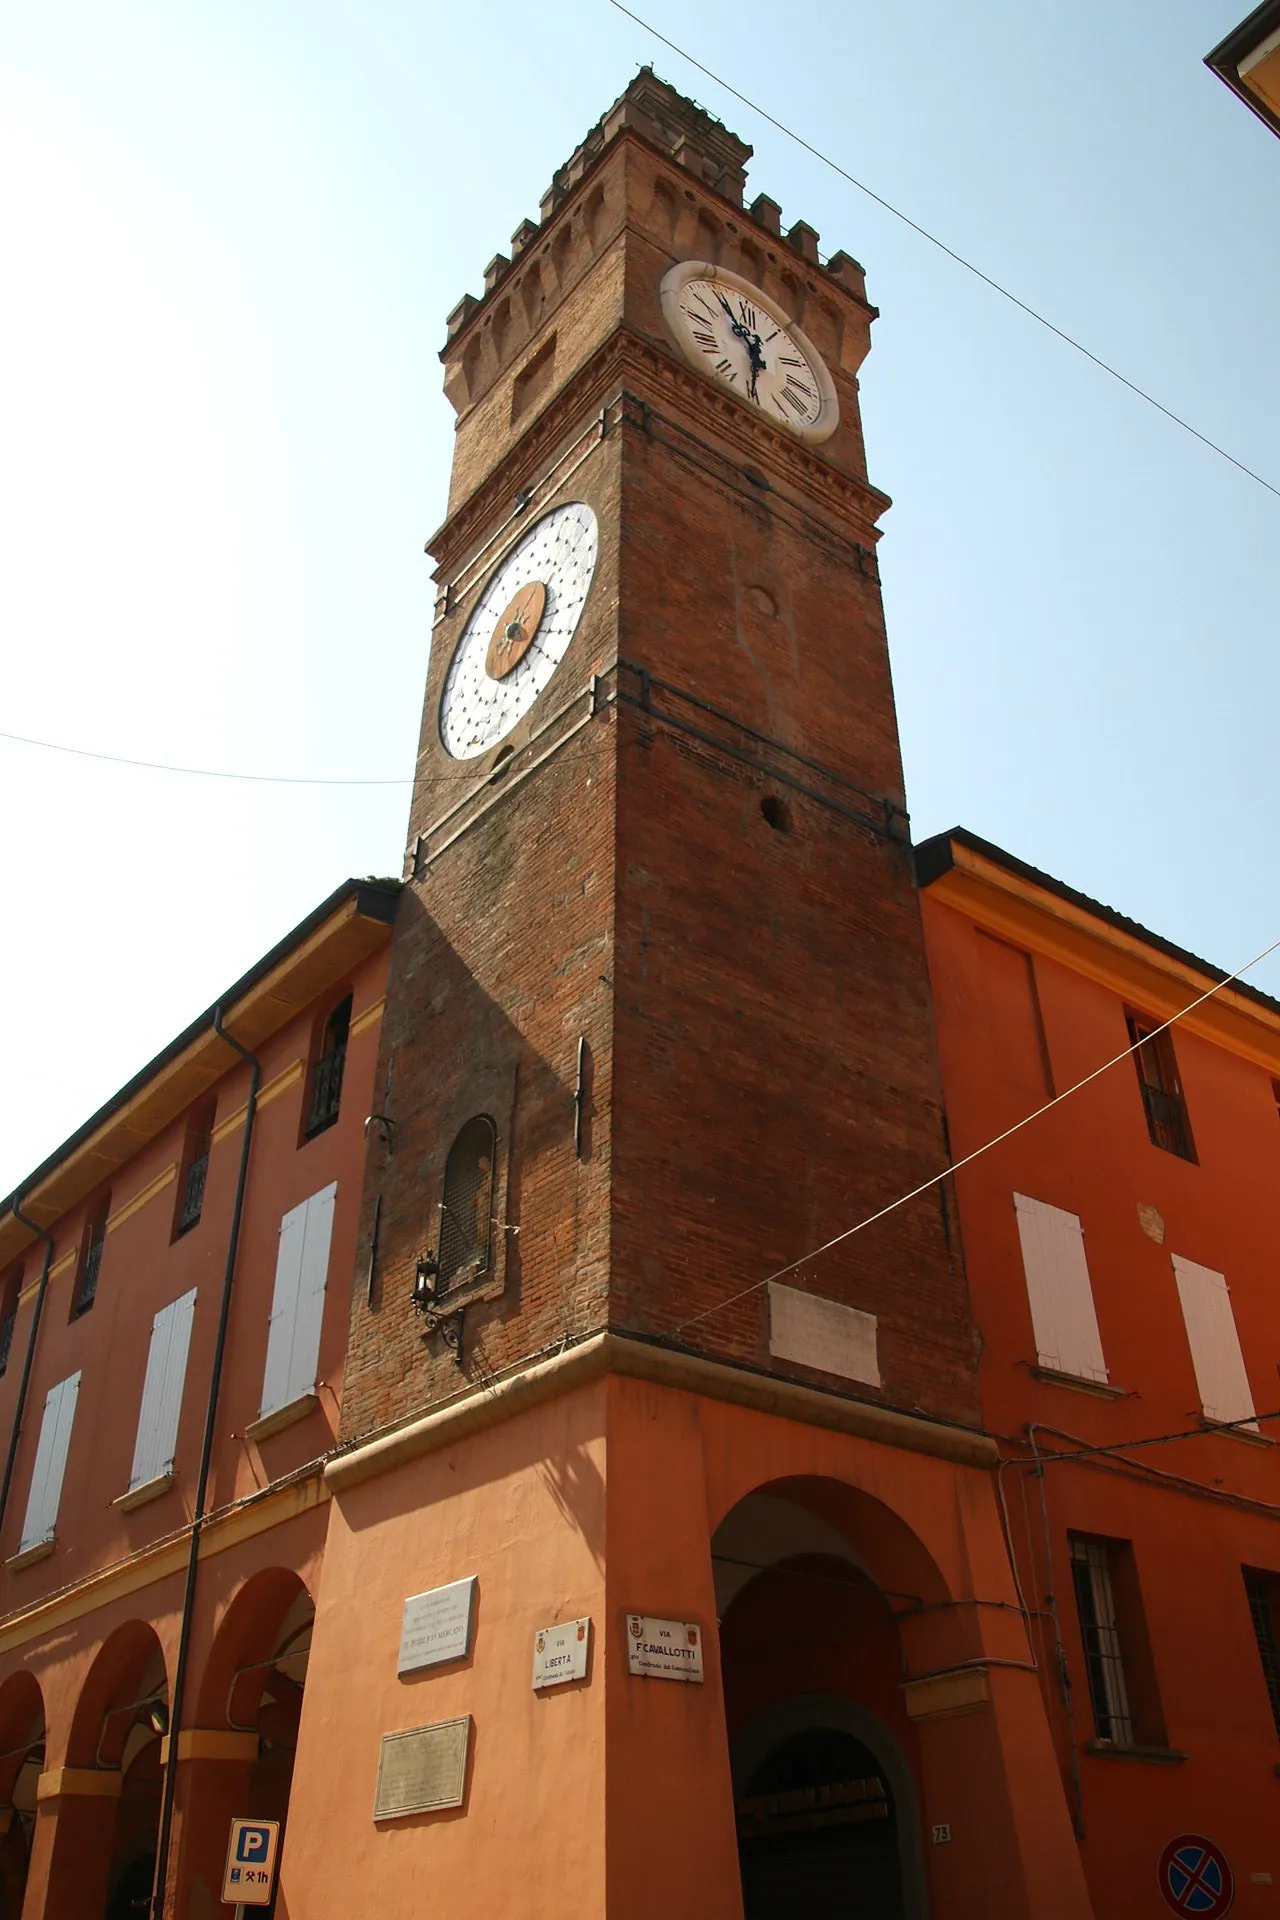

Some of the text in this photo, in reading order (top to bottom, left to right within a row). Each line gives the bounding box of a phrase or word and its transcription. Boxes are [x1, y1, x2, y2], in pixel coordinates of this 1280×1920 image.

[739, 301, 756, 331] XII
[934, 1826, 948, 1841] 73
[243, 1831, 263, 1858] P
[257, 1871, 269, 1883] 1h
